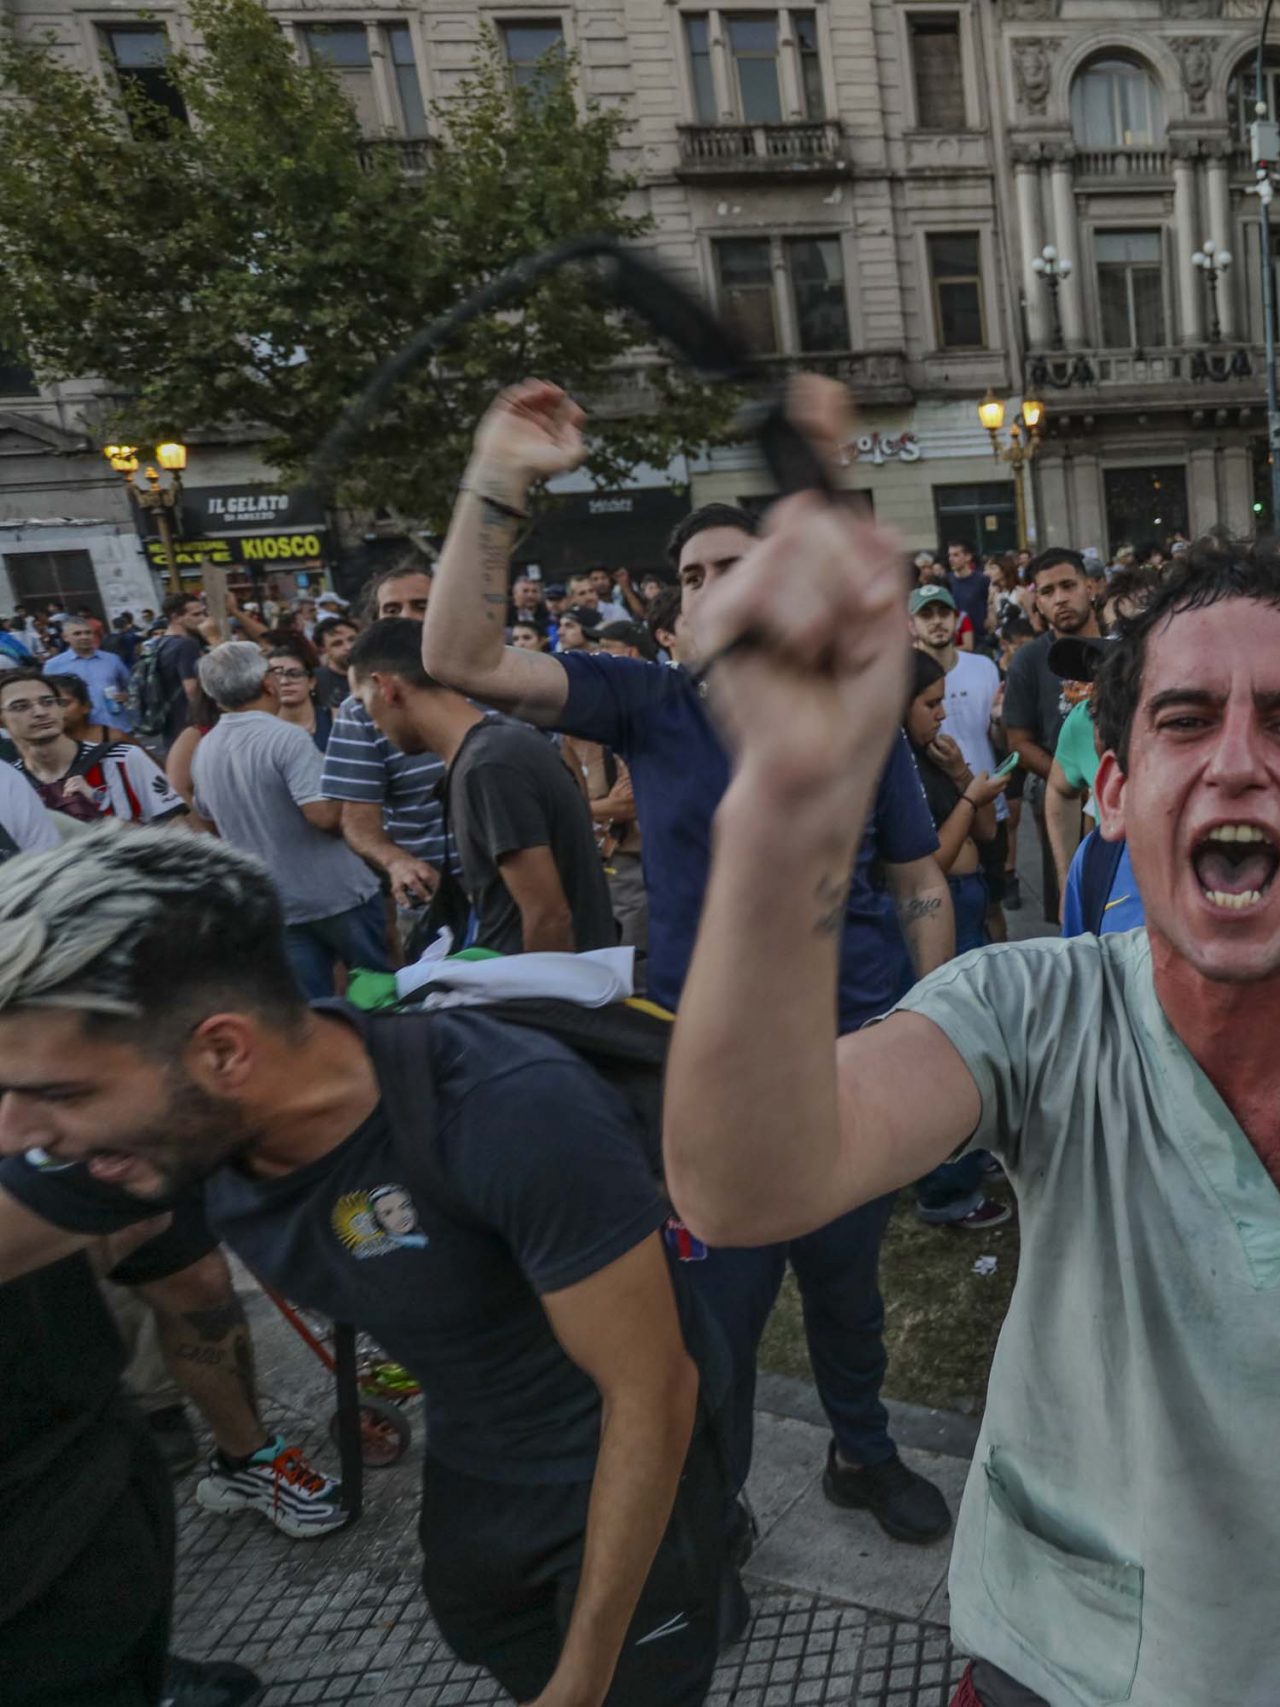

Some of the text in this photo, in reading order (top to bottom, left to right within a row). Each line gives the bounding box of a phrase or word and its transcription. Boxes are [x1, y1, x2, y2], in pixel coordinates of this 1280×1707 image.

[208, 495, 289, 514] IL GELATO
[241, 535, 320, 559] KIOSCO
